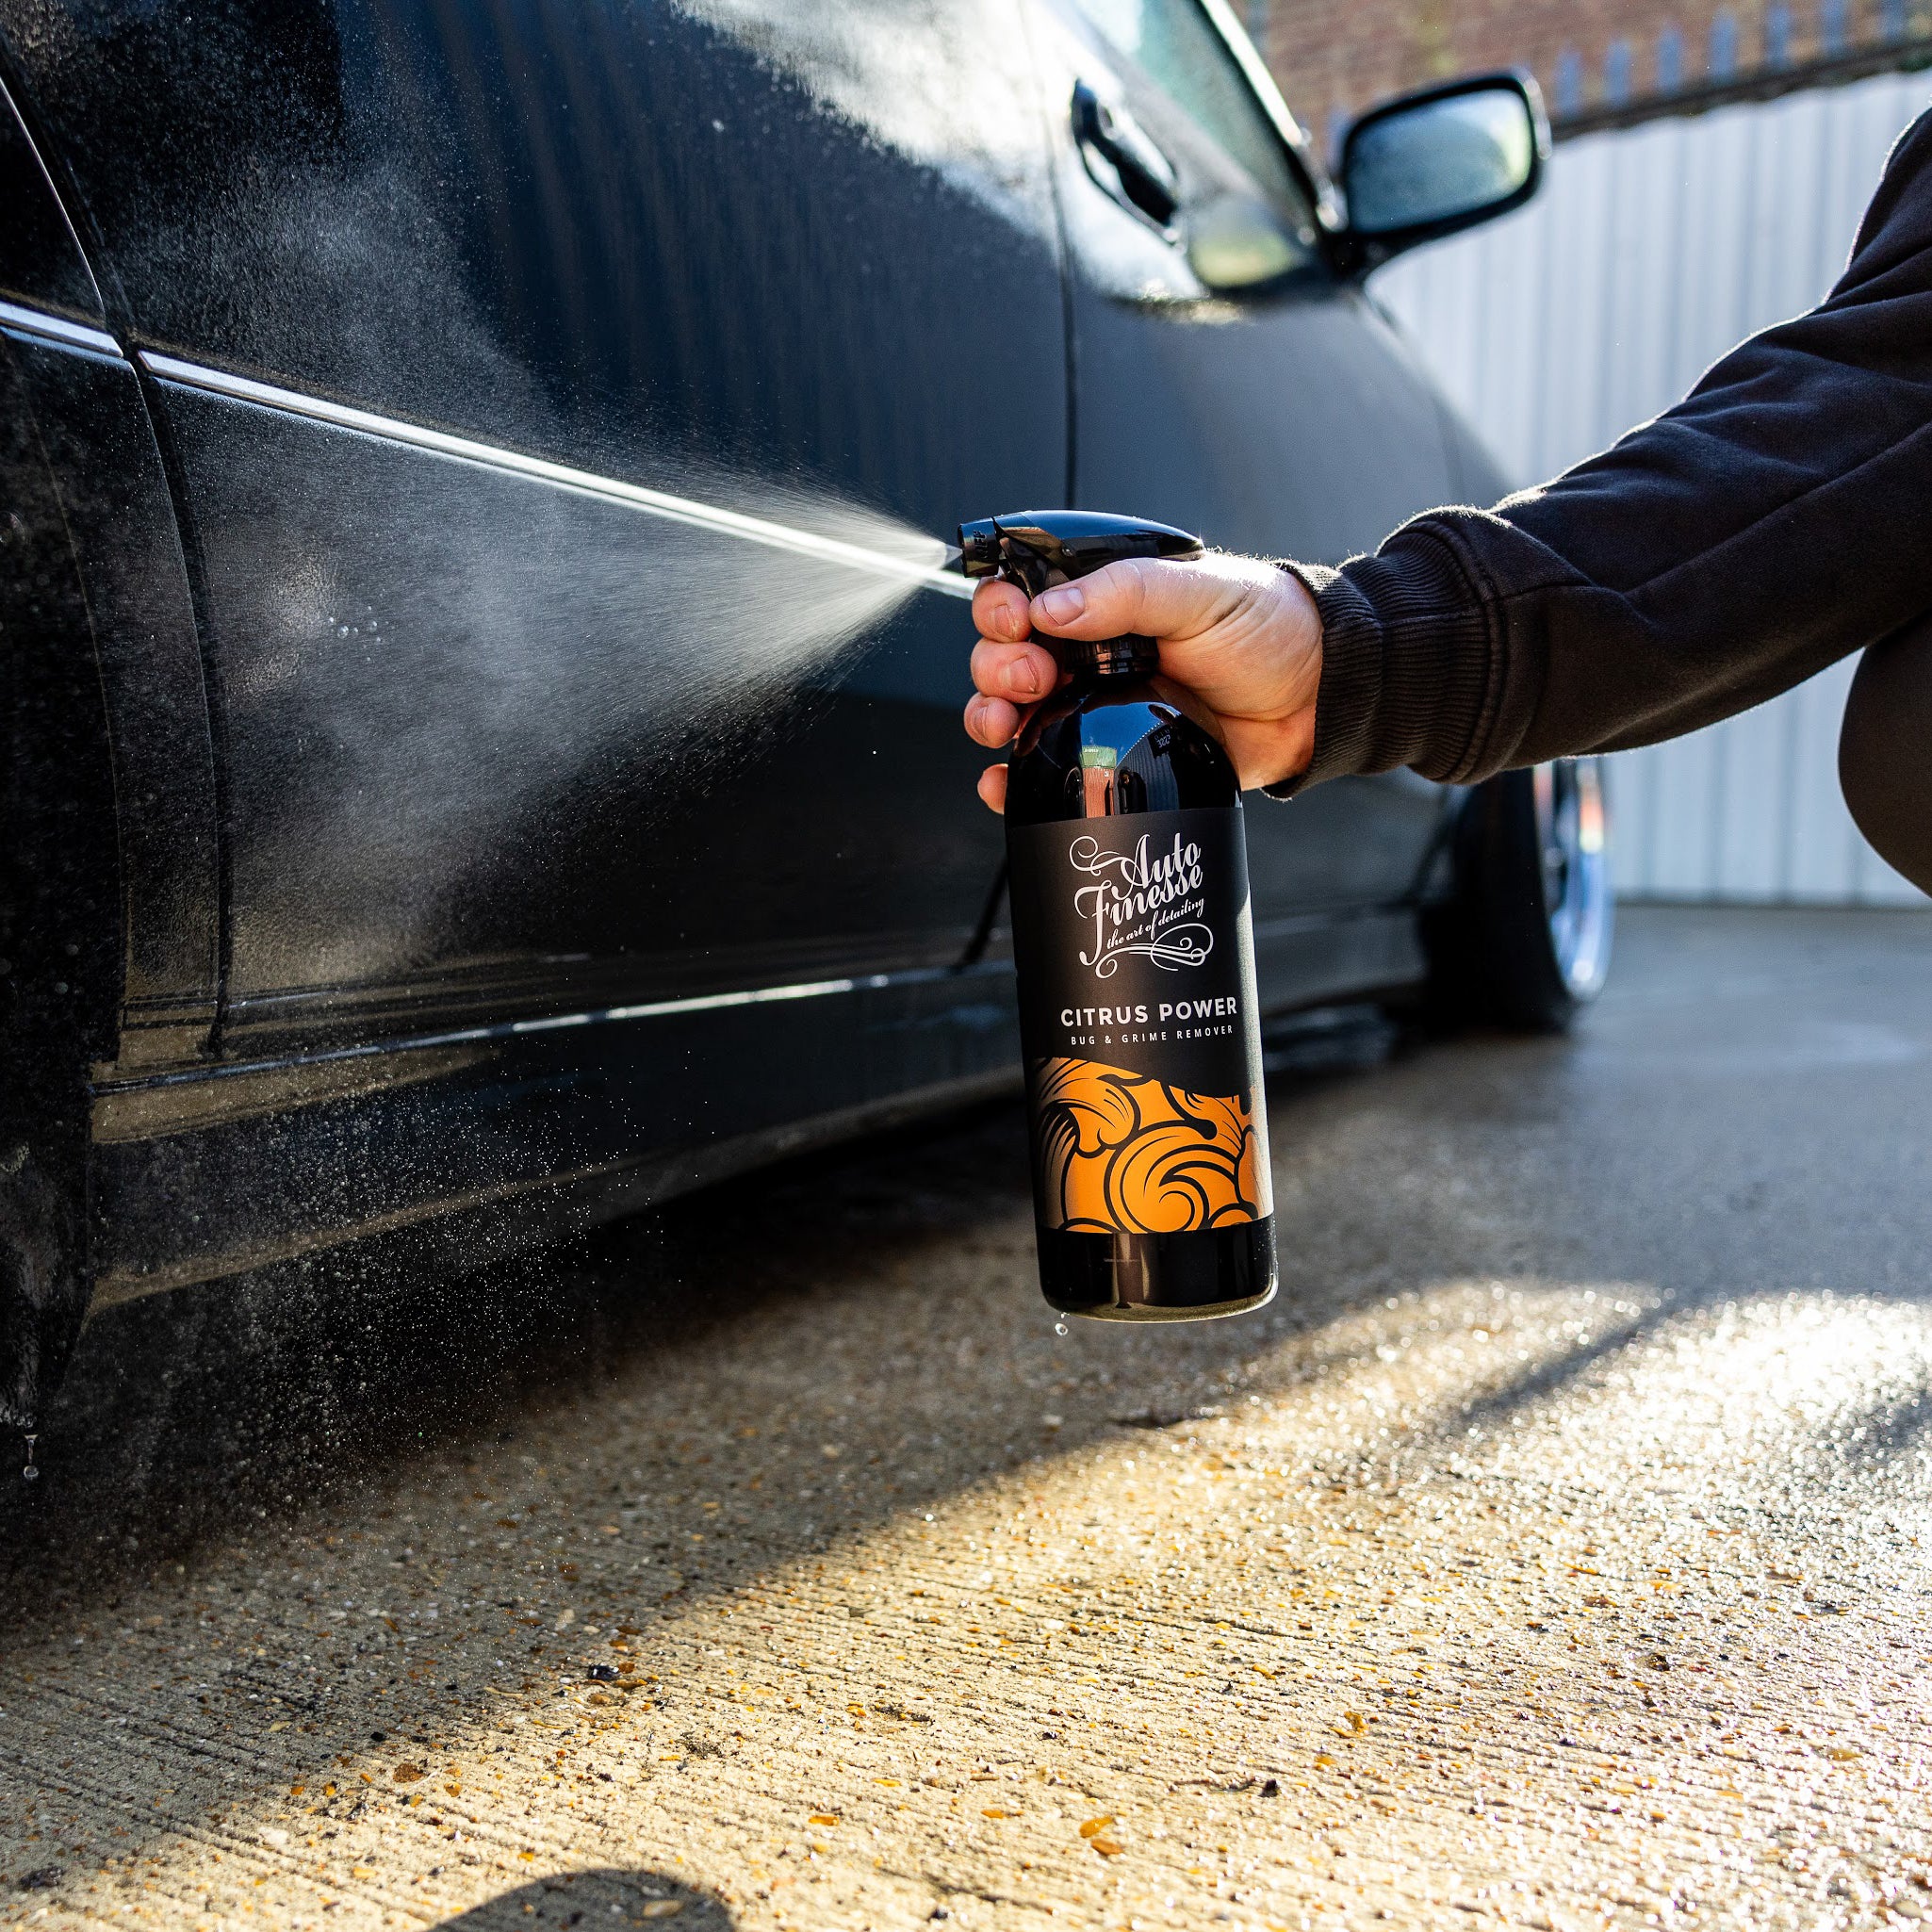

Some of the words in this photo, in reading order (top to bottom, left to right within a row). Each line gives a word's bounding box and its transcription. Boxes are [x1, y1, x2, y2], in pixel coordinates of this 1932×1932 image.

[1069, 832, 1202, 901] Auto
[1073, 864, 1203, 966] Finesse
[1106, 928, 1124, 949] the
[1125, 925, 1144, 940] art
[1145, 910, 1159, 941] of
[1157, 898, 1204, 926] detailing
[1060, 1005, 1149, 1027] CITRUS
[1158, 996, 1237, 1022] POWER
[1071, 1036, 1096, 1045] BUG
[1105, 1035, 1112, 1044] &
[1122, 1031, 1168, 1043] GRIME
[1176, 1024, 1234, 1040] REMOVER
